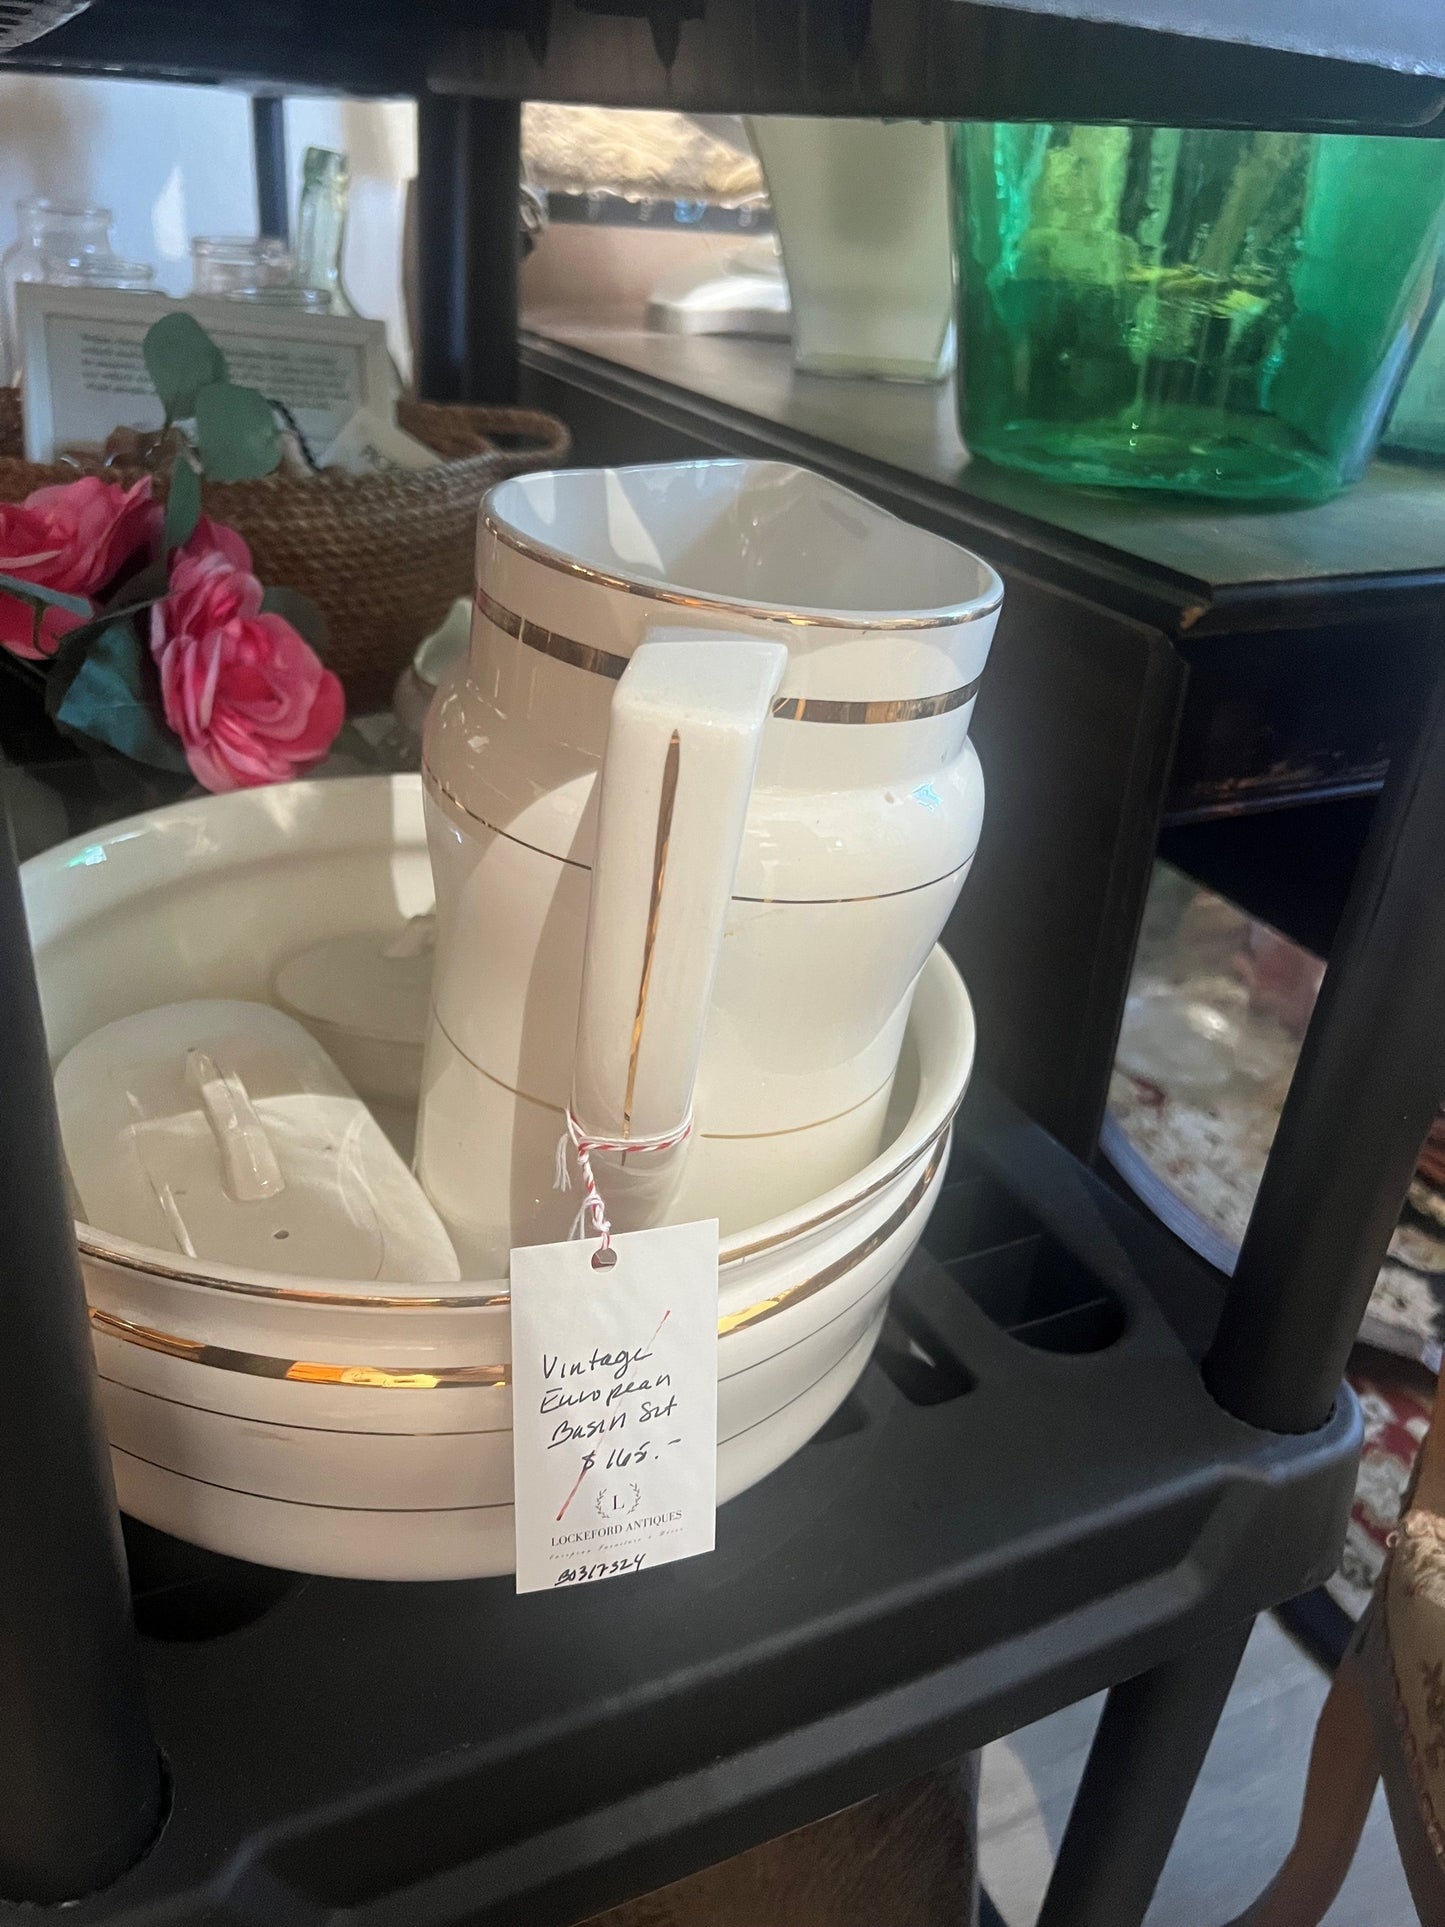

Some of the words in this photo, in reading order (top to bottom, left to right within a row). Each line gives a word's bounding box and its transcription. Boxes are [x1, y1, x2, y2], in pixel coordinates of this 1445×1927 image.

[543, 1347, 653, 1380] Vintage
[540, 1373, 671, 1414] European
[547, 1412, 627, 1449] Basin
[639, 1394, 678, 1423] Set
[612, 1494, 625, 1510] L
[551, 1525, 623, 1547] LOCKEFORD
[625, 1509, 683, 1532] ANTIQUES
